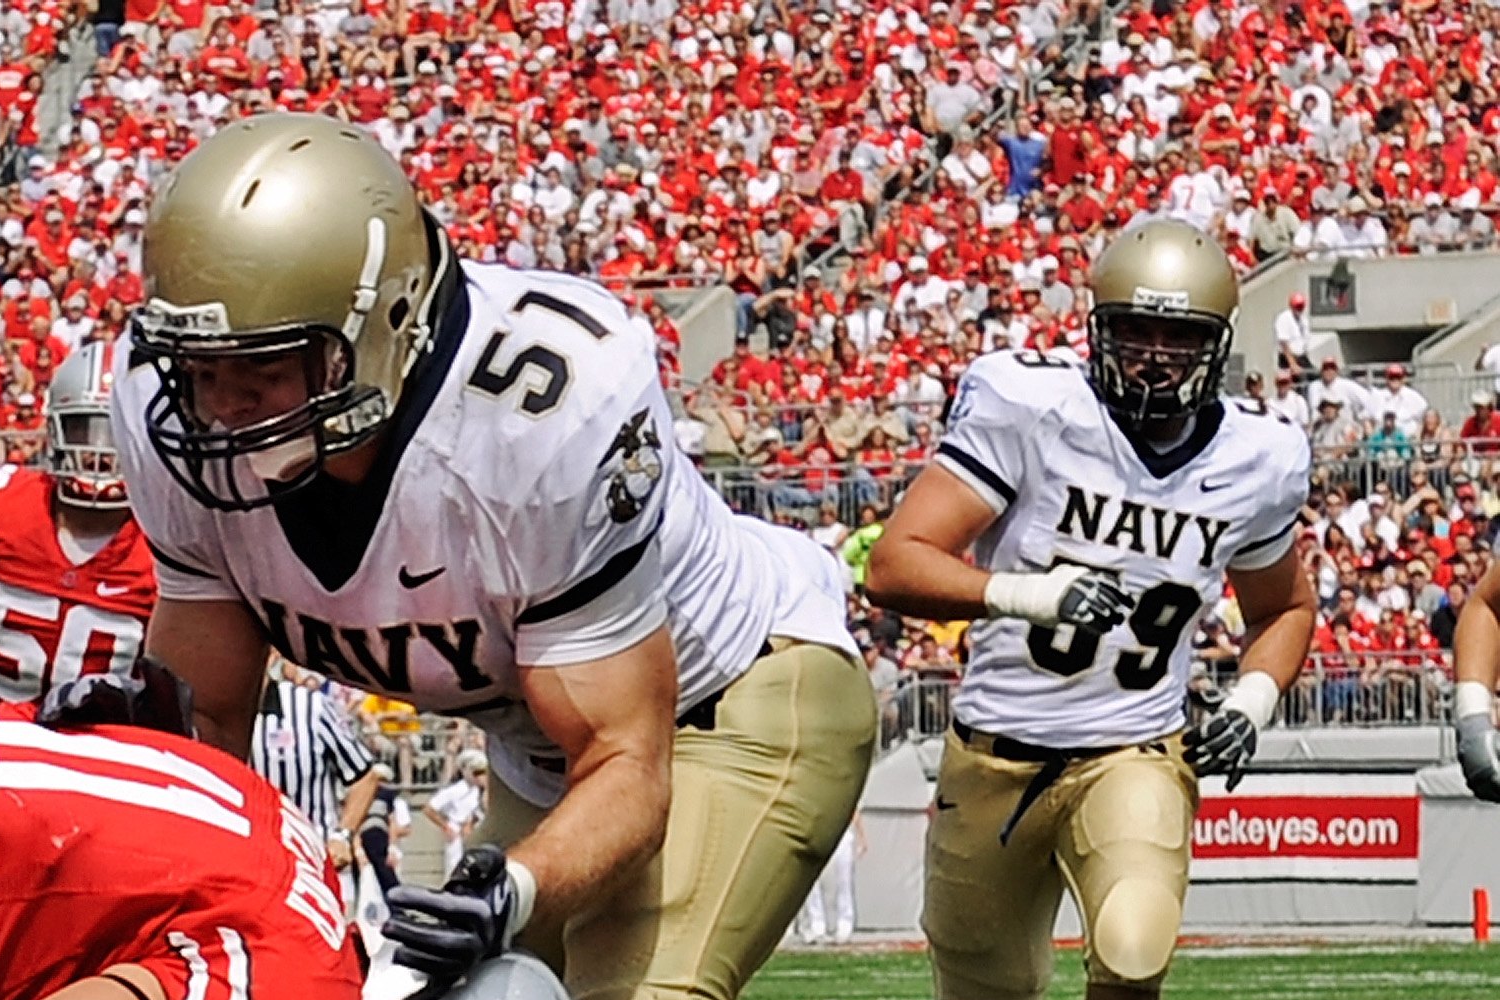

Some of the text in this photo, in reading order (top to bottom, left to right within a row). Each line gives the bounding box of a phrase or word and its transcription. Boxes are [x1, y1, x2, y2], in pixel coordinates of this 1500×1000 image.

[466, 290, 613, 416] 51
[1056, 483, 1232, 569] NAVY
[1193, 808, 1399, 853] uckeyes.com
